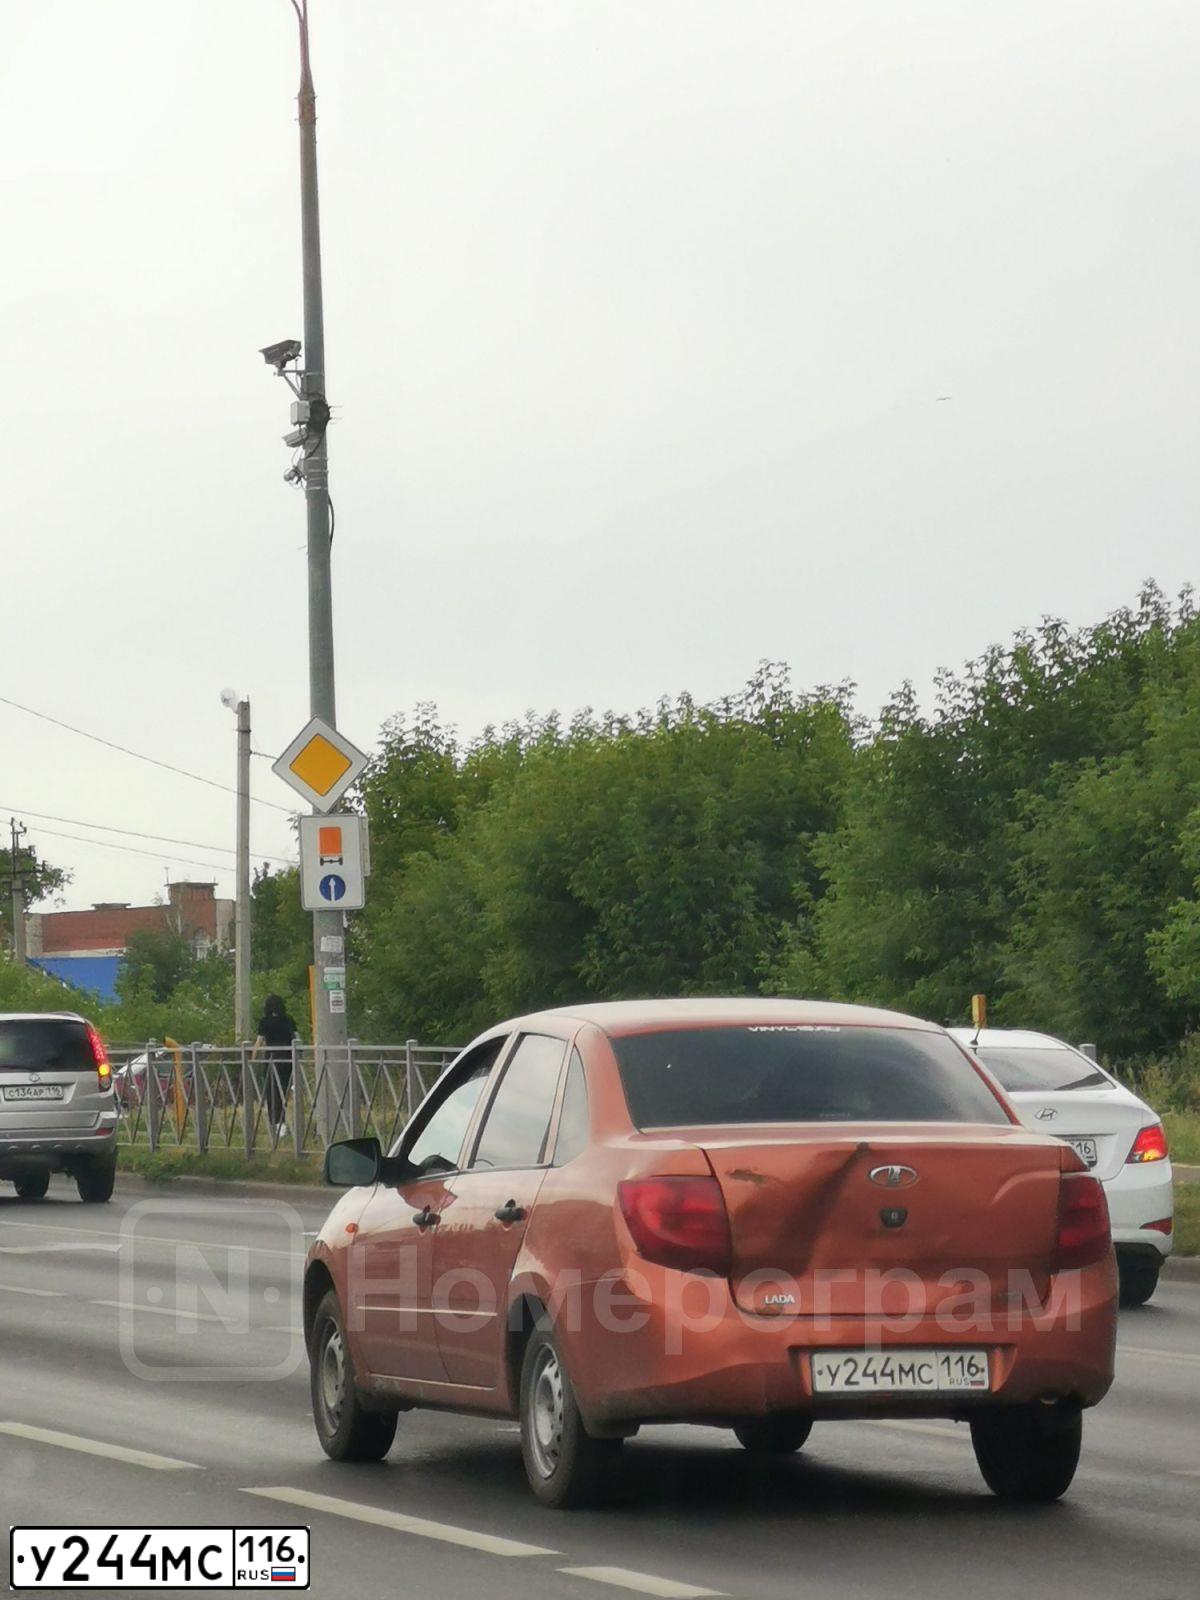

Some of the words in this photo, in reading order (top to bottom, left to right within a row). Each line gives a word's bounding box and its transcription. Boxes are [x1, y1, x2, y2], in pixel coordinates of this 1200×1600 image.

[764, 1294, 796, 1304] LADA
[826, 1356, 933, 1386] У244МС
[940, 1354, 980, 1377] 116
[949, 1377, 970, 1386] RUS
